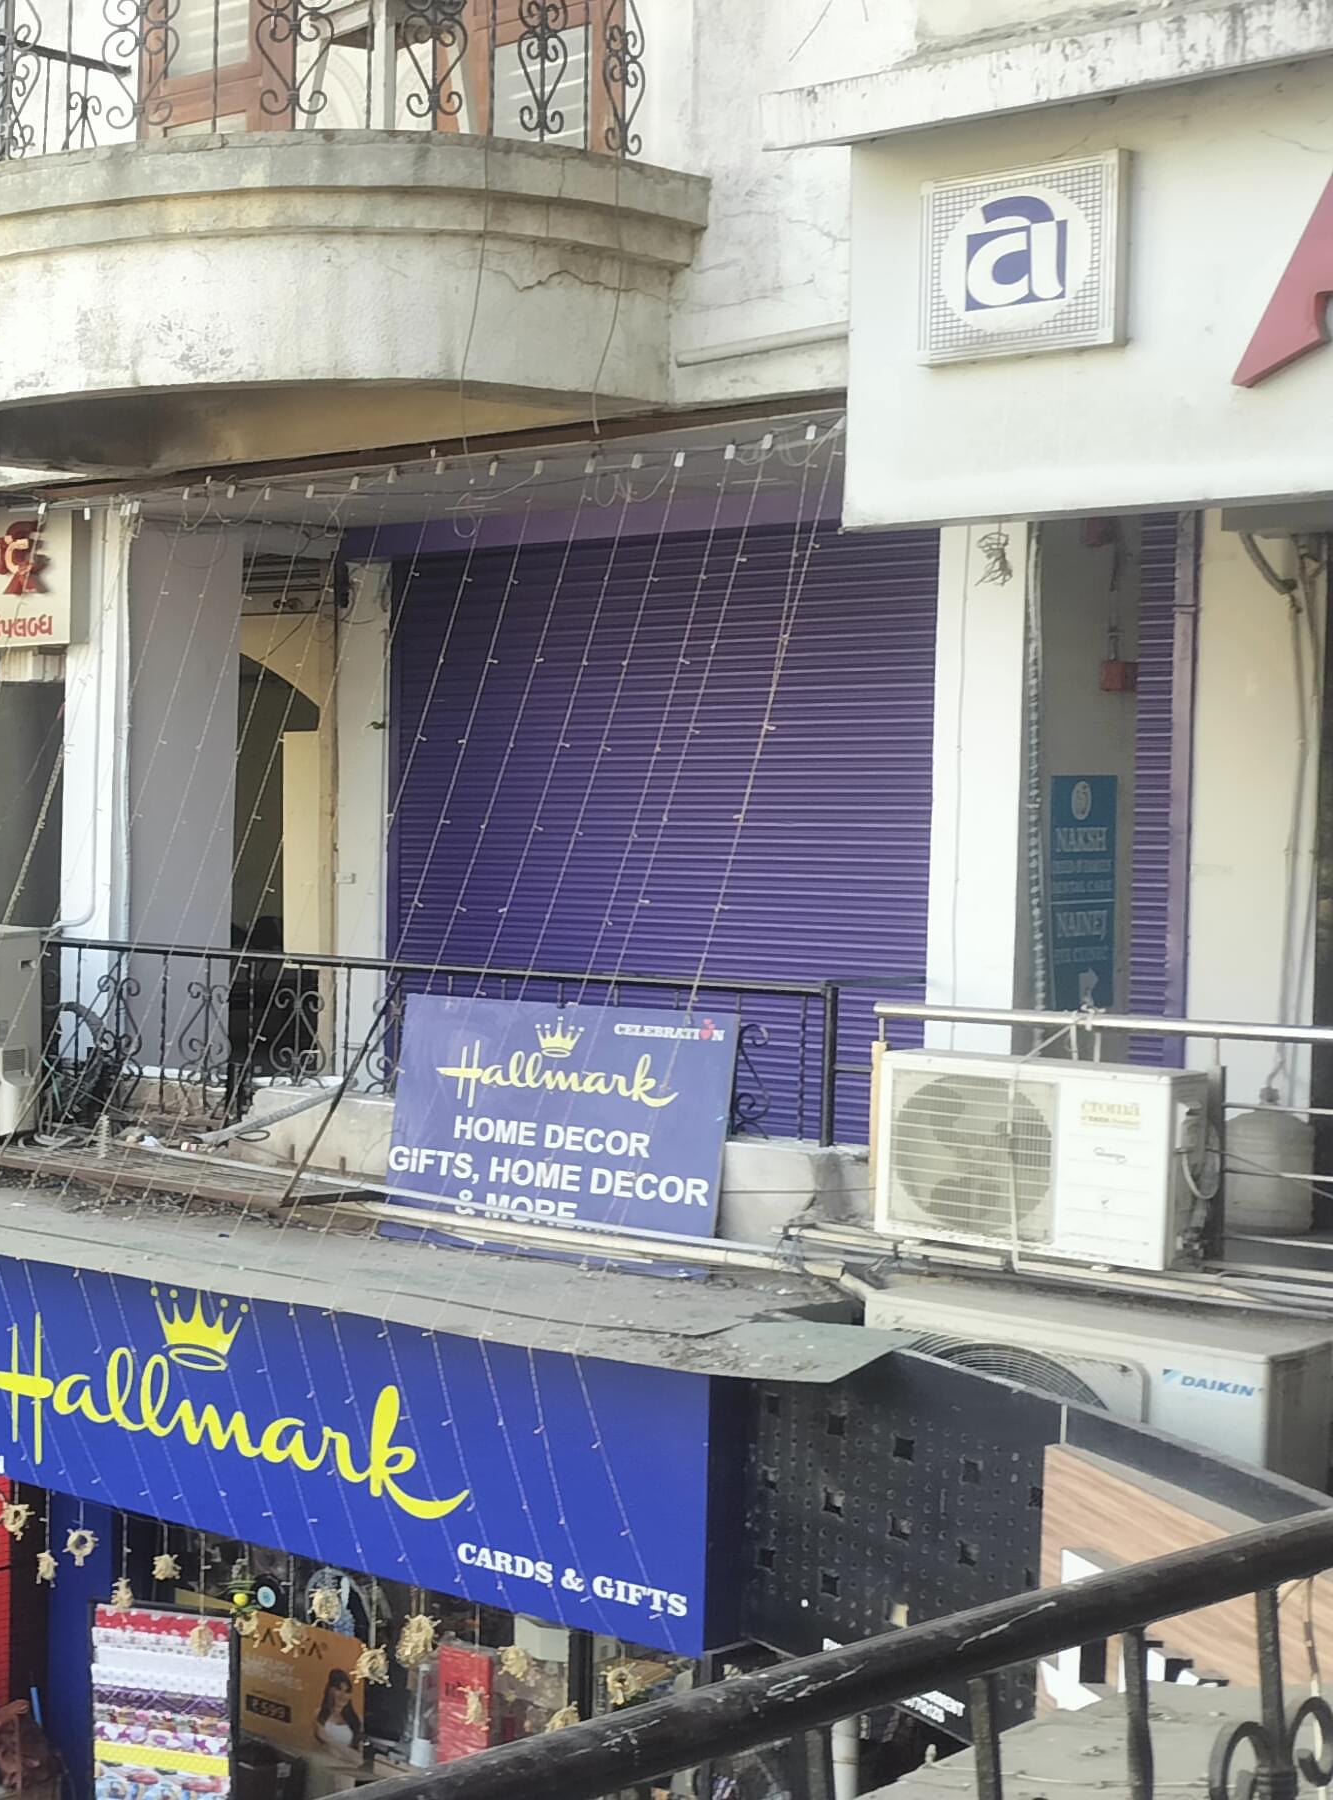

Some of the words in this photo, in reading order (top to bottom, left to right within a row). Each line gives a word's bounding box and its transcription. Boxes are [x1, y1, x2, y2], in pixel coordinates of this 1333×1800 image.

[1055, 827, 1108, 853] NAKSH
[435, 1039, 680, 1109] Hallmark
[453, 1114, 538, 1147] HOME
[543, 1123, 652, 1159] DECOR
[488, 1156, 582, 1193] HOME
[589, 1166, 710, 1208] DECOR
[1180, 1374, 1256, 1398] DAIKIN
[456, 1542, 554, 1584] CARDS
[560, 1567, 585, 1593] &
[592, 1575, 688, 1618] GIFTS
